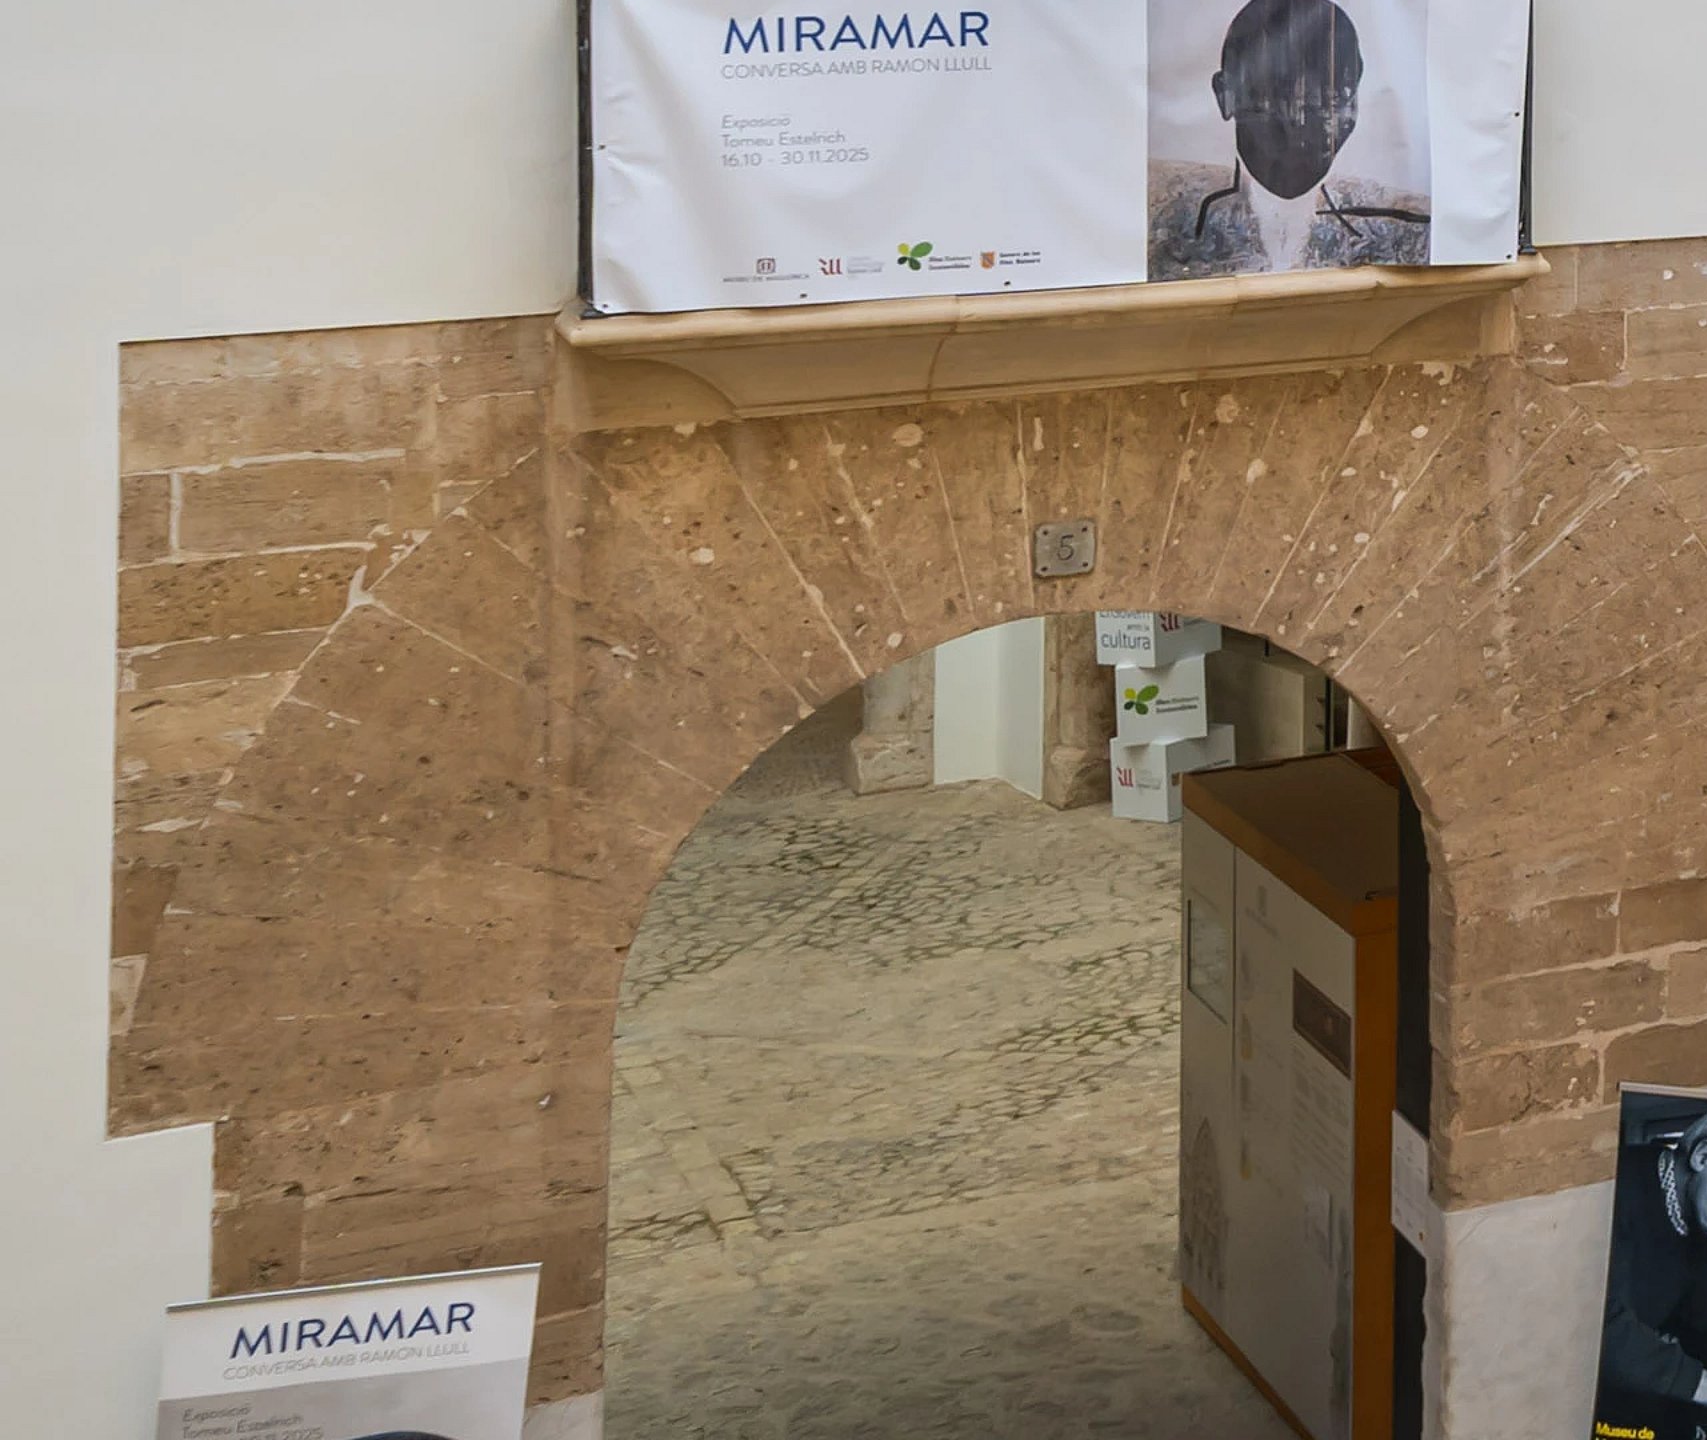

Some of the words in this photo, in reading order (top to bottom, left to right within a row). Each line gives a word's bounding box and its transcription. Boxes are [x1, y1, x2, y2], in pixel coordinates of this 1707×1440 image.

[724, 10, 989, 54] MIRAMAR
[720, 61, 824, 80] CONVERSA
[827, 59, 867, 75] AMB
[871, 57, 940, 73] RAMON
[944, 56, 992, 71] LLULL
[1056, 534, 1075, 561] 5
[1100, 630, 1151, 650] cultura
[228, 1302, 477, 1359] MIRAMAR
[222, 1356, 316, 1381] CONVERSA
[359, 1346, 424, 1364] RAMON
